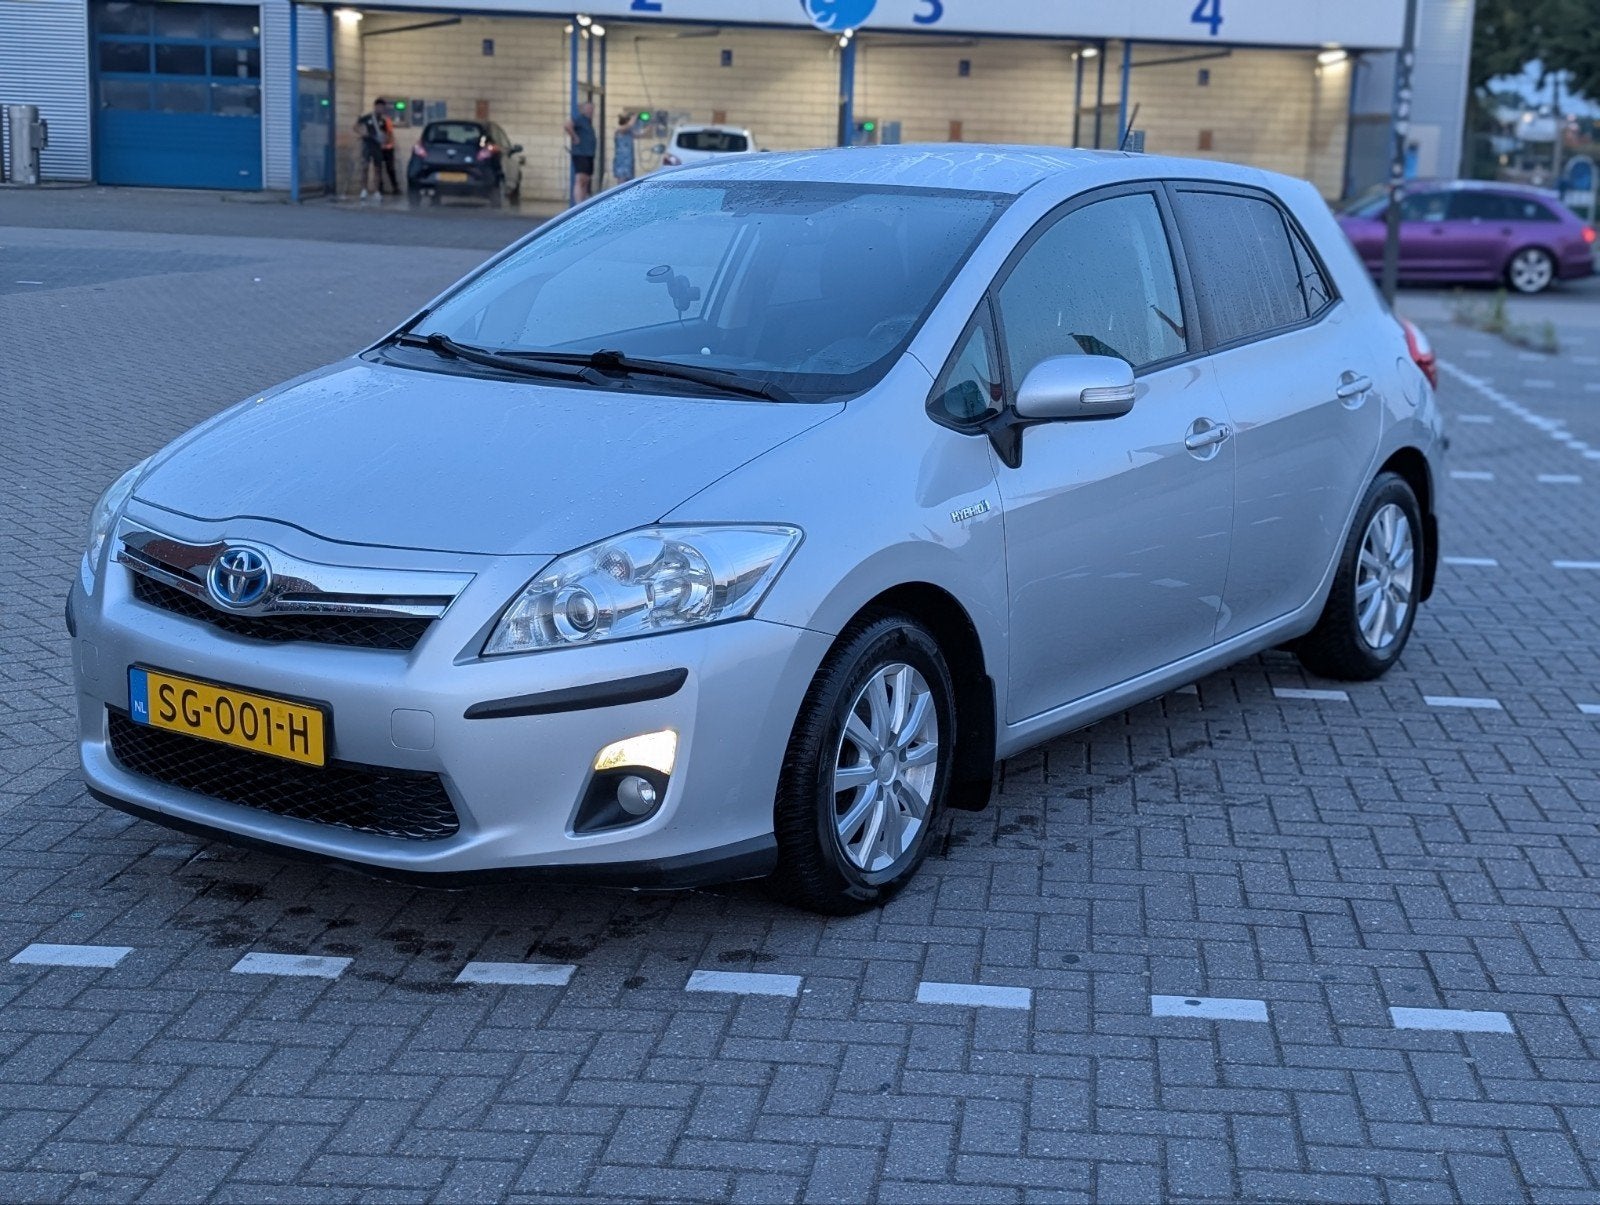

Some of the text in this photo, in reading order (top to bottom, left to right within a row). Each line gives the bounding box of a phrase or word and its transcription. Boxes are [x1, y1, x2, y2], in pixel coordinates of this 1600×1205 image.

[1190, 0, 1223, 36] 4
[134, 683, 309, 755] NL SG-001-H
